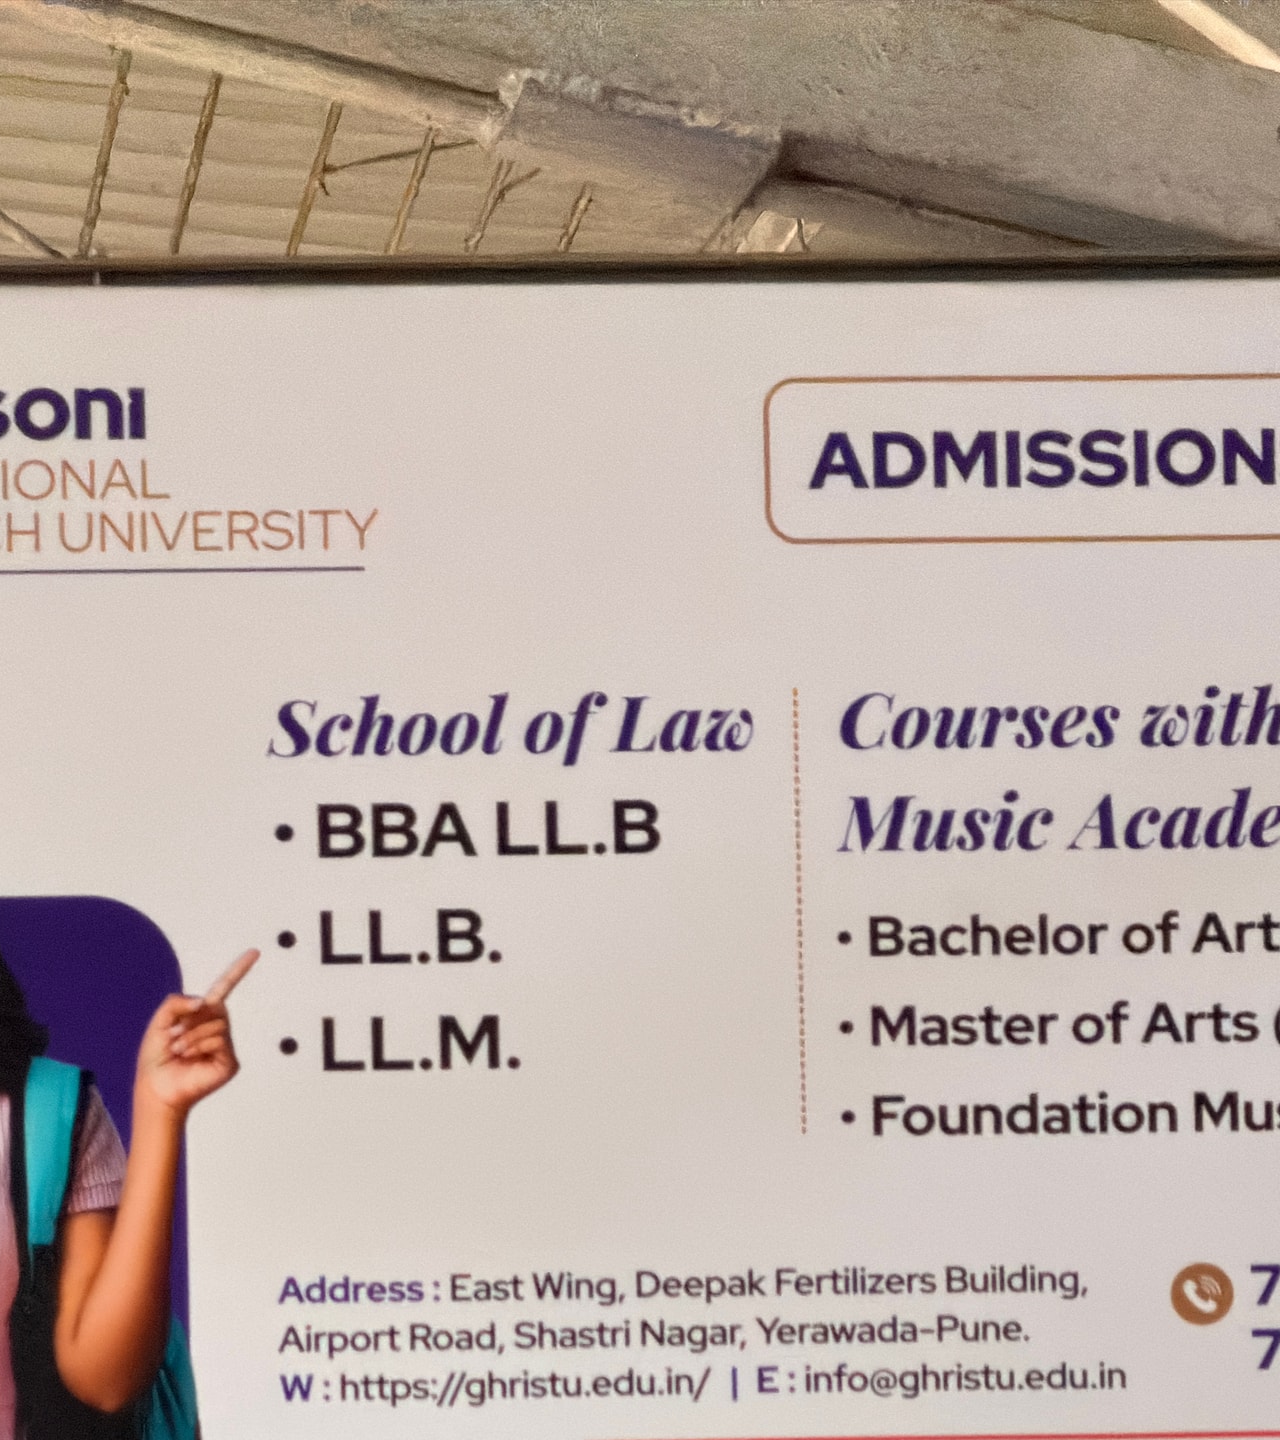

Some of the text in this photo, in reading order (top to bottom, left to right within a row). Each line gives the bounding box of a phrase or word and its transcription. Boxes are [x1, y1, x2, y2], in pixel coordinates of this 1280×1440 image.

[57, 507, 379, 554] UNIVERSITY
[268, 690, 755, 767] School of Law
[839, 692, 1121, 750] Courses
[317, 799, 661, 859] BBA LL.B
[837, 789, 1054, 853] Music
[319, 908, 502, 966] LL.B.
[868, 913, 1109, 957] Bachelor
[1121, 909, 1180, 955] of
[322, 1014, 521, 1072] LL.M.
[870, 1005, 1059, 1047] Master
[1071, 1000, 1130, 1045] of
[1141, 1002, 1260, 1044] Arts
[872, 1090, 1178, 1137] Foundation
[449, 1273, 524, 1302] East
[531, 1271, 626, 1307] Wing,
[635, 1268, 767, 1304] Deepak
[775, 1266, 938, 1297] Fertilizers
[945, 1264, 1088, 1301] Building,
[278, 1313, 1030, 1359] Airport Road, Shastri Nagar, Yerawada-Pune.
[340, 1360, 1127, 1408] https://ghristu.edu.in/ info@ghristu.edu.in
